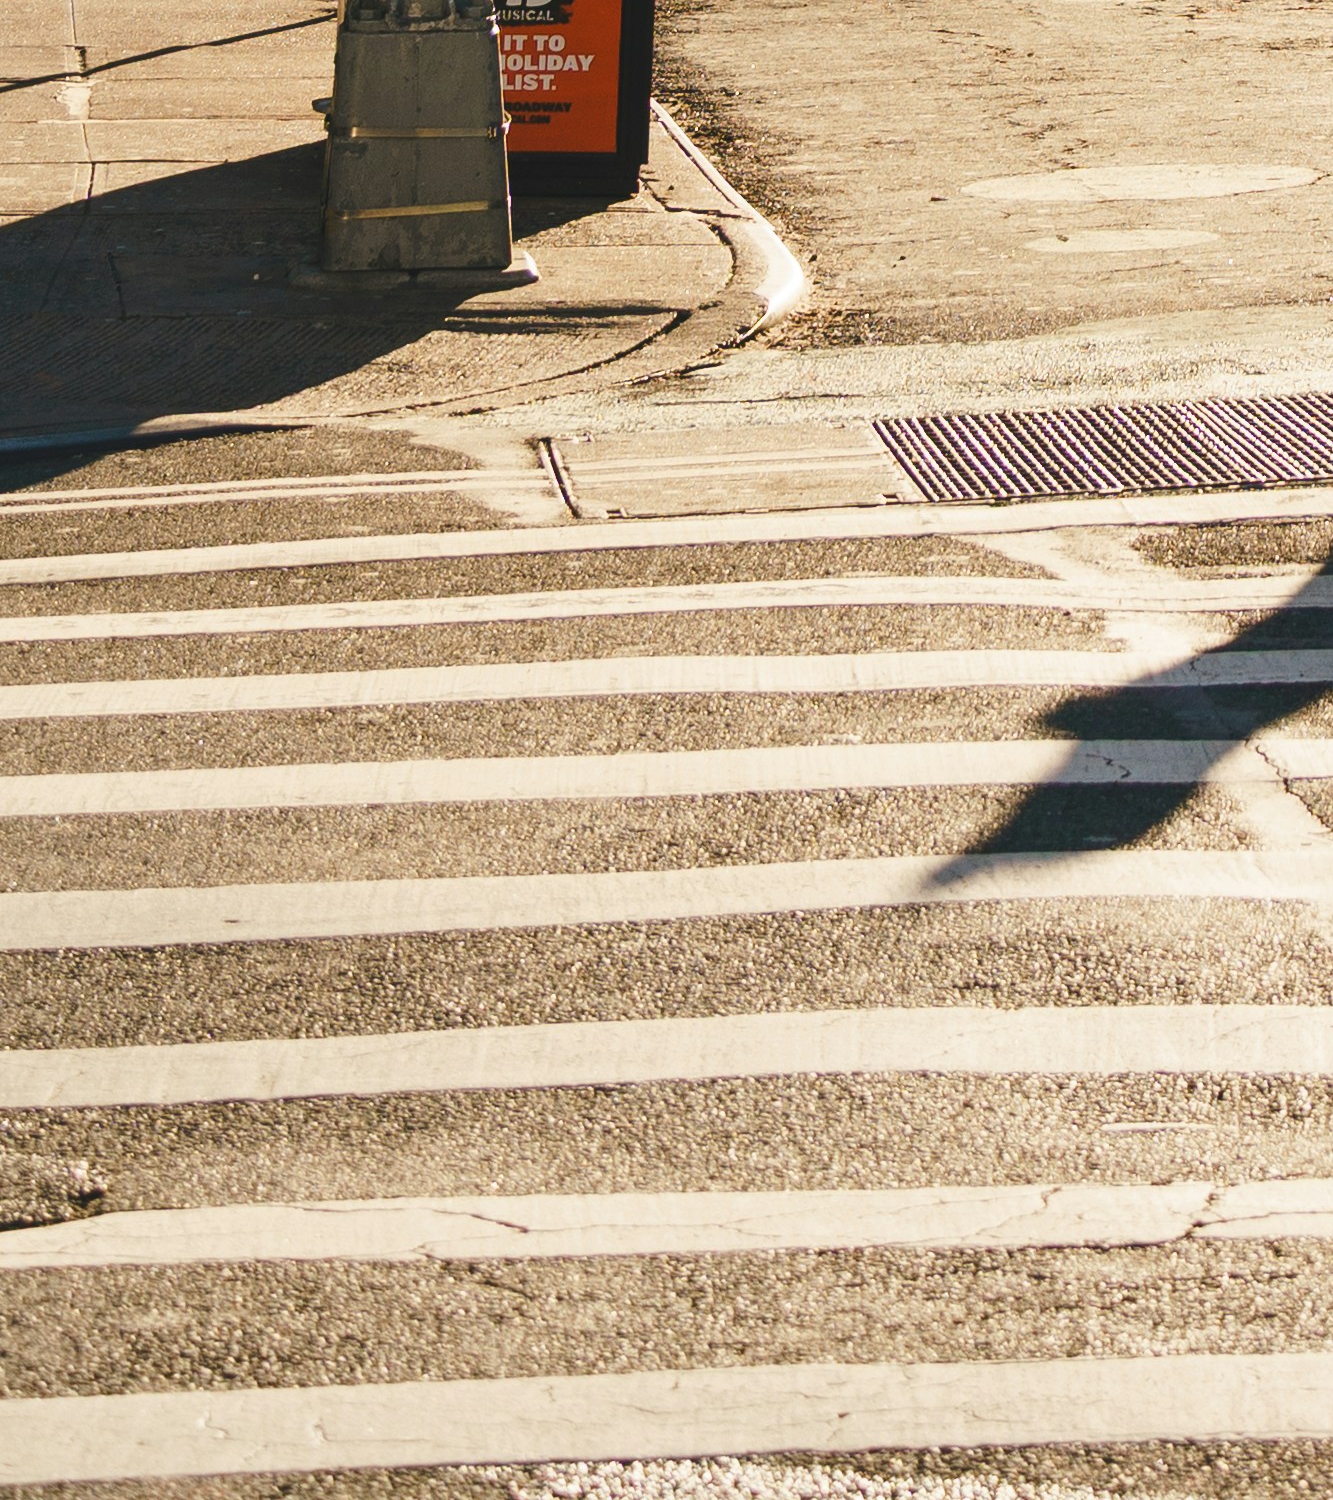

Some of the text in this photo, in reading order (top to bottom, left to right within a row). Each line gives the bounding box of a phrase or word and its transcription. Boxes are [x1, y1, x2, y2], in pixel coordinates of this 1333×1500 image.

[503, 34, 566, 52] IT TO
[503, 73, 557, 91] LIST.
